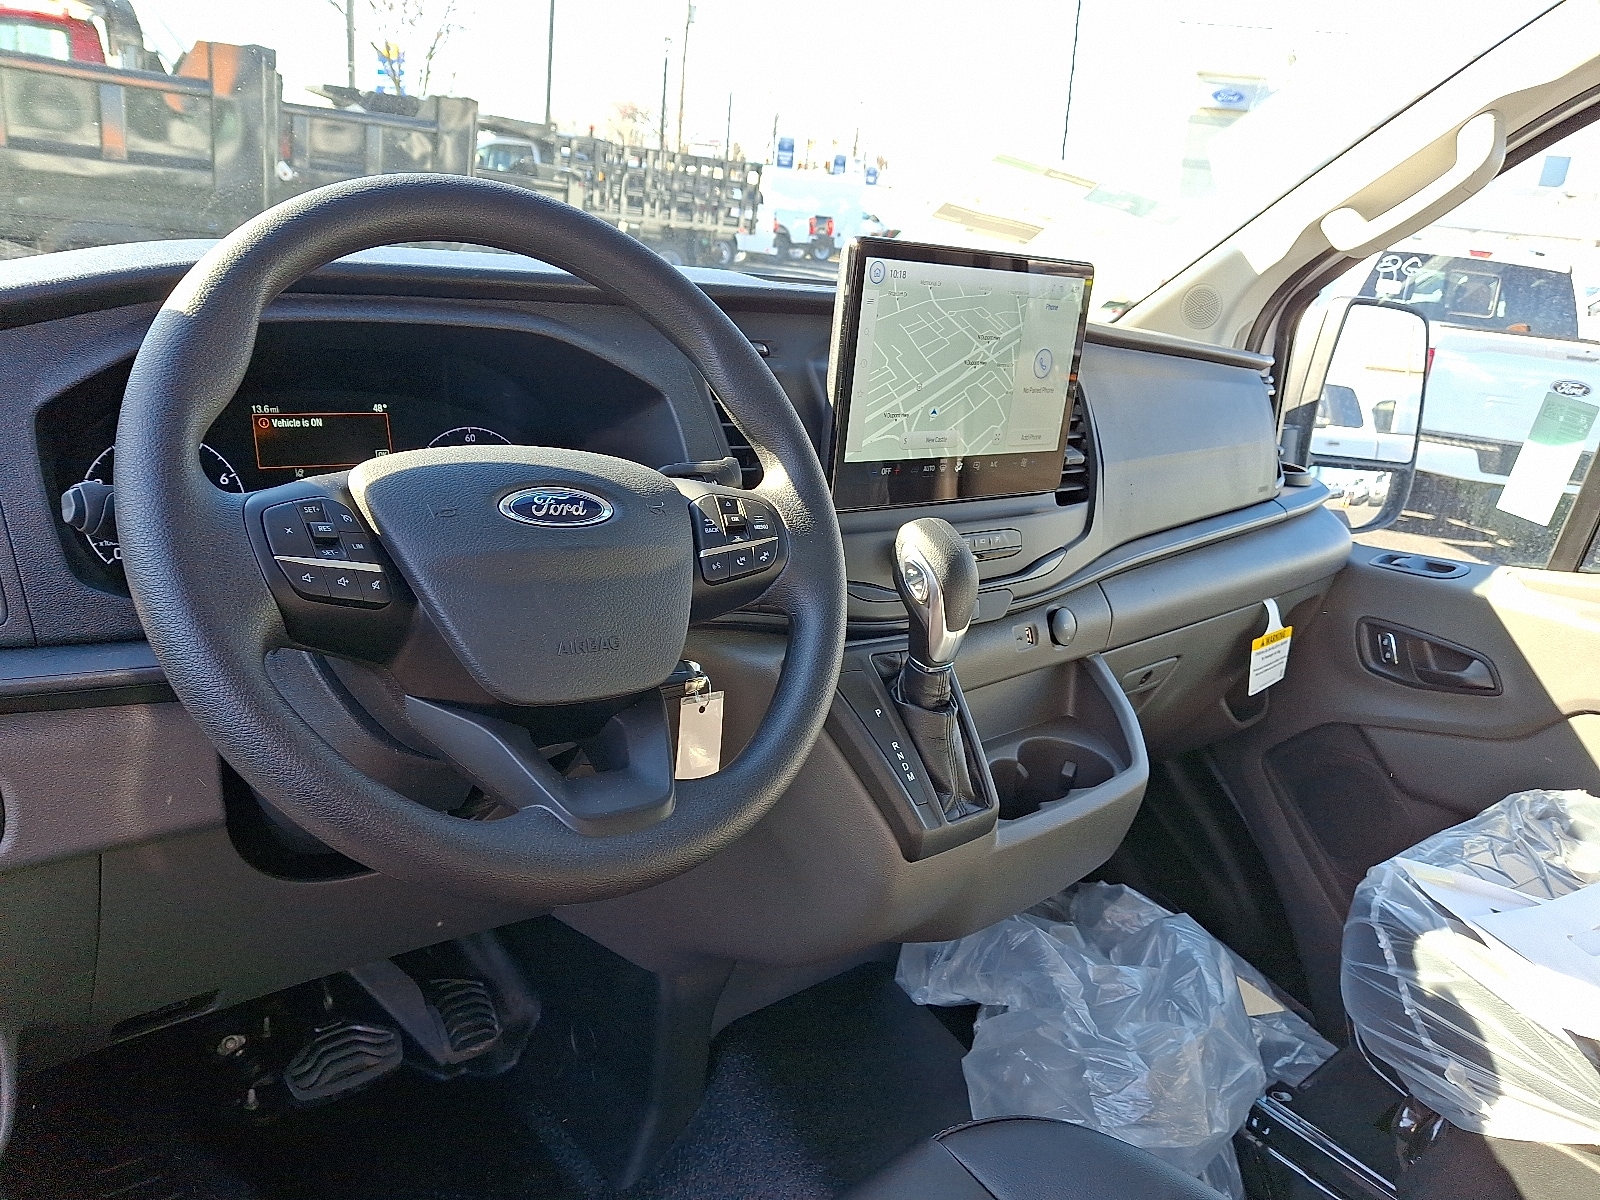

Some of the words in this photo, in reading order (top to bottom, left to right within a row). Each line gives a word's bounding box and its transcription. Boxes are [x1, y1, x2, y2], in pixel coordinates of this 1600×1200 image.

[889, 269, 907, 279] 10:18
[1045, 303, 1059, 311] Phone
[271, 418, 300, 427] Vehicle
[302, 418, 309, 427] is
[310, 418, 323, 427] ON
[464, 433, 476, 443] 60
[881, 467, 892, 475] OFF
[922, 464, 936, 472] AUTO
[219, 473, 229, 485] 6
[531, 493, 587, 517] Ford
[557, 636, 620, 656] AIRBAG
[874, 708, 882, 718] P
[891, 741, 900, 751] R
[896, 752, 904, 760] N
[902, 762, 909, 771] D
[906, 772, 915, 781] M
